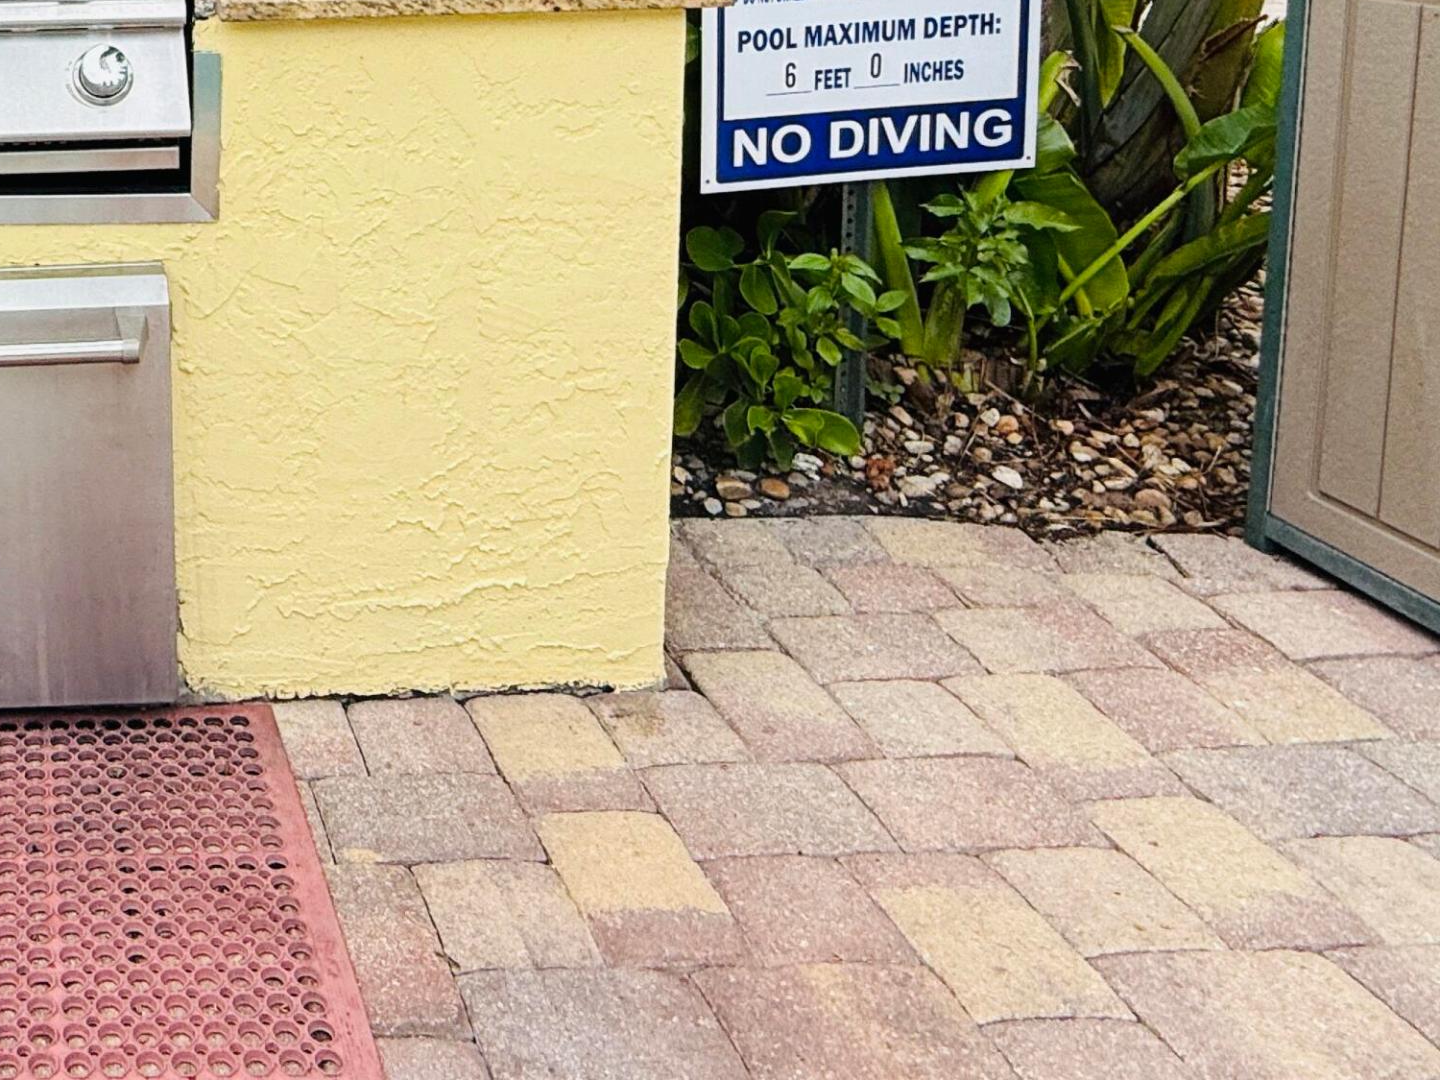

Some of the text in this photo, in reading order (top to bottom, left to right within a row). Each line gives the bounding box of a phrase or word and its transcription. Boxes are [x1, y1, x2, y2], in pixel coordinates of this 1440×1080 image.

[737, 13, 1001, 53] POOL MAXIMUM DEPTH:
[785, 62, 796, 88] 6
[814, 67, 851, 91] FEET
[904, 59, 964, 84] INCHES
[733, 108, 1013, 168] NO DIVING
